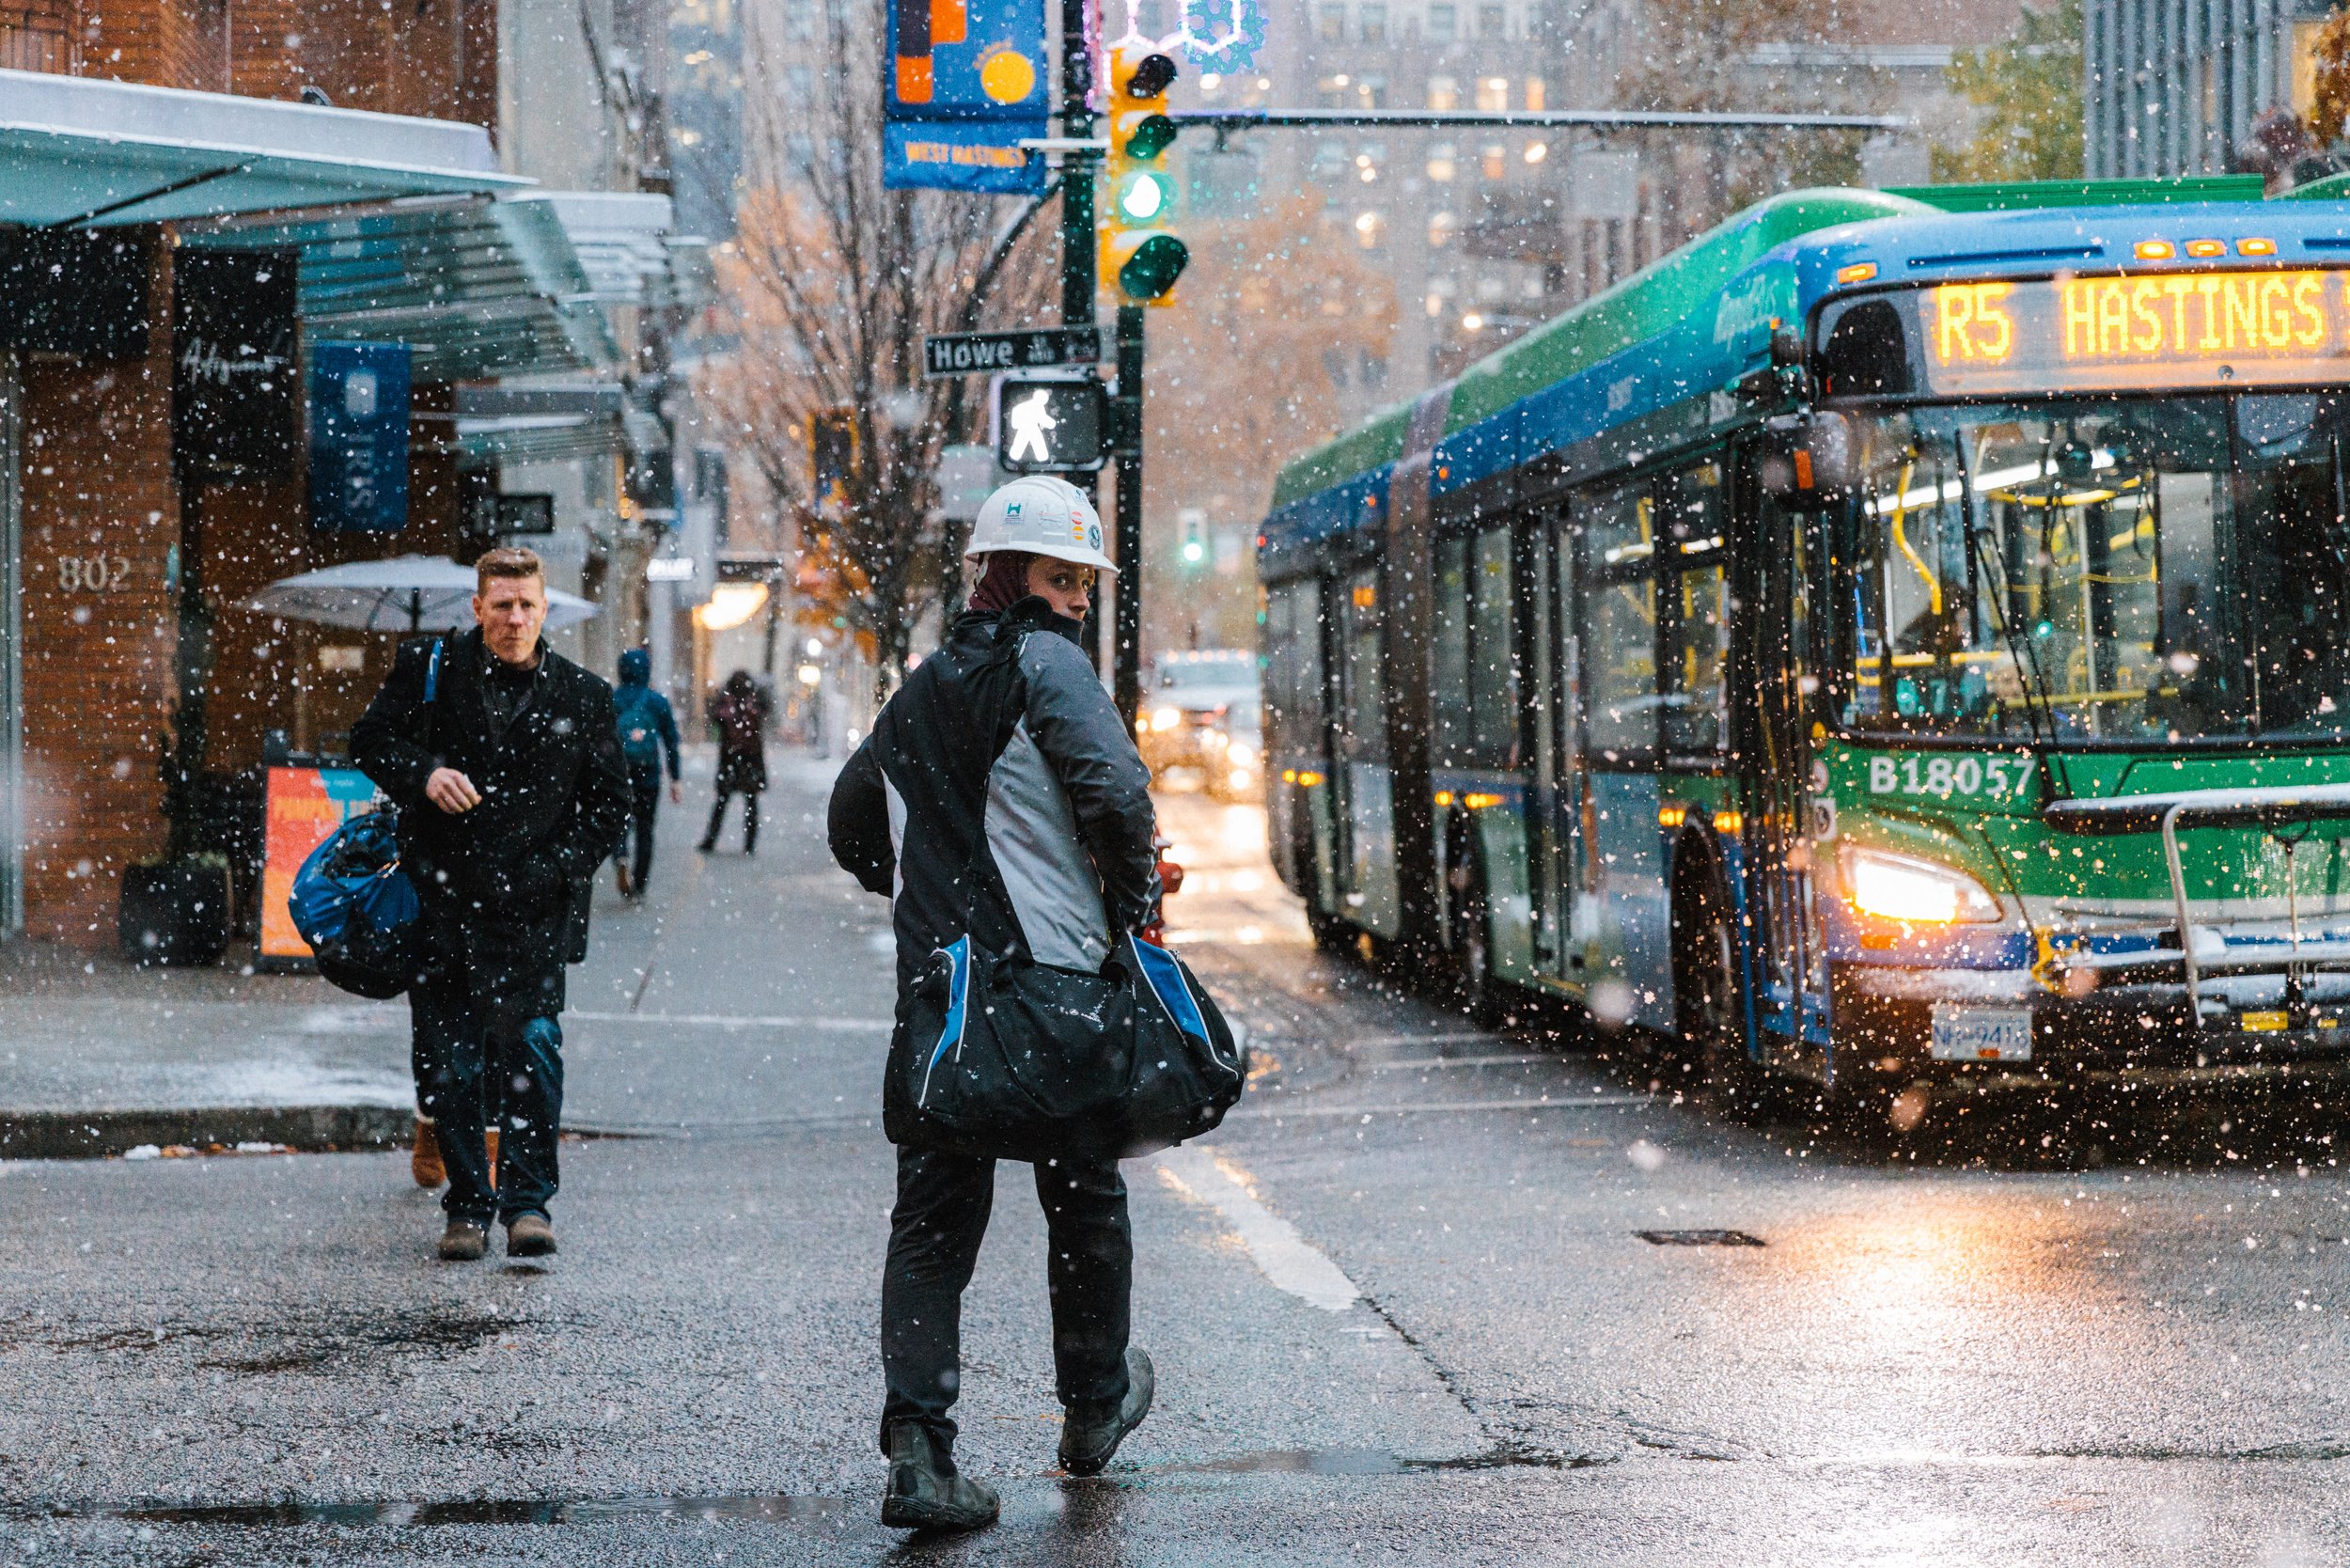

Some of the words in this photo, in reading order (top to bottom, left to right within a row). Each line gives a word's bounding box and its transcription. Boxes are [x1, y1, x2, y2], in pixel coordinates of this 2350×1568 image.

[905, 141, 949, 164] WEST
[1938, 284, 2012, 358] R5
[2065, 274, 2324, 353] HASTINGS
[934, 339, 1015, 369] Howe
[58, 556, 131, 592] 802
[1870, 755, 2036, 795] B18057
